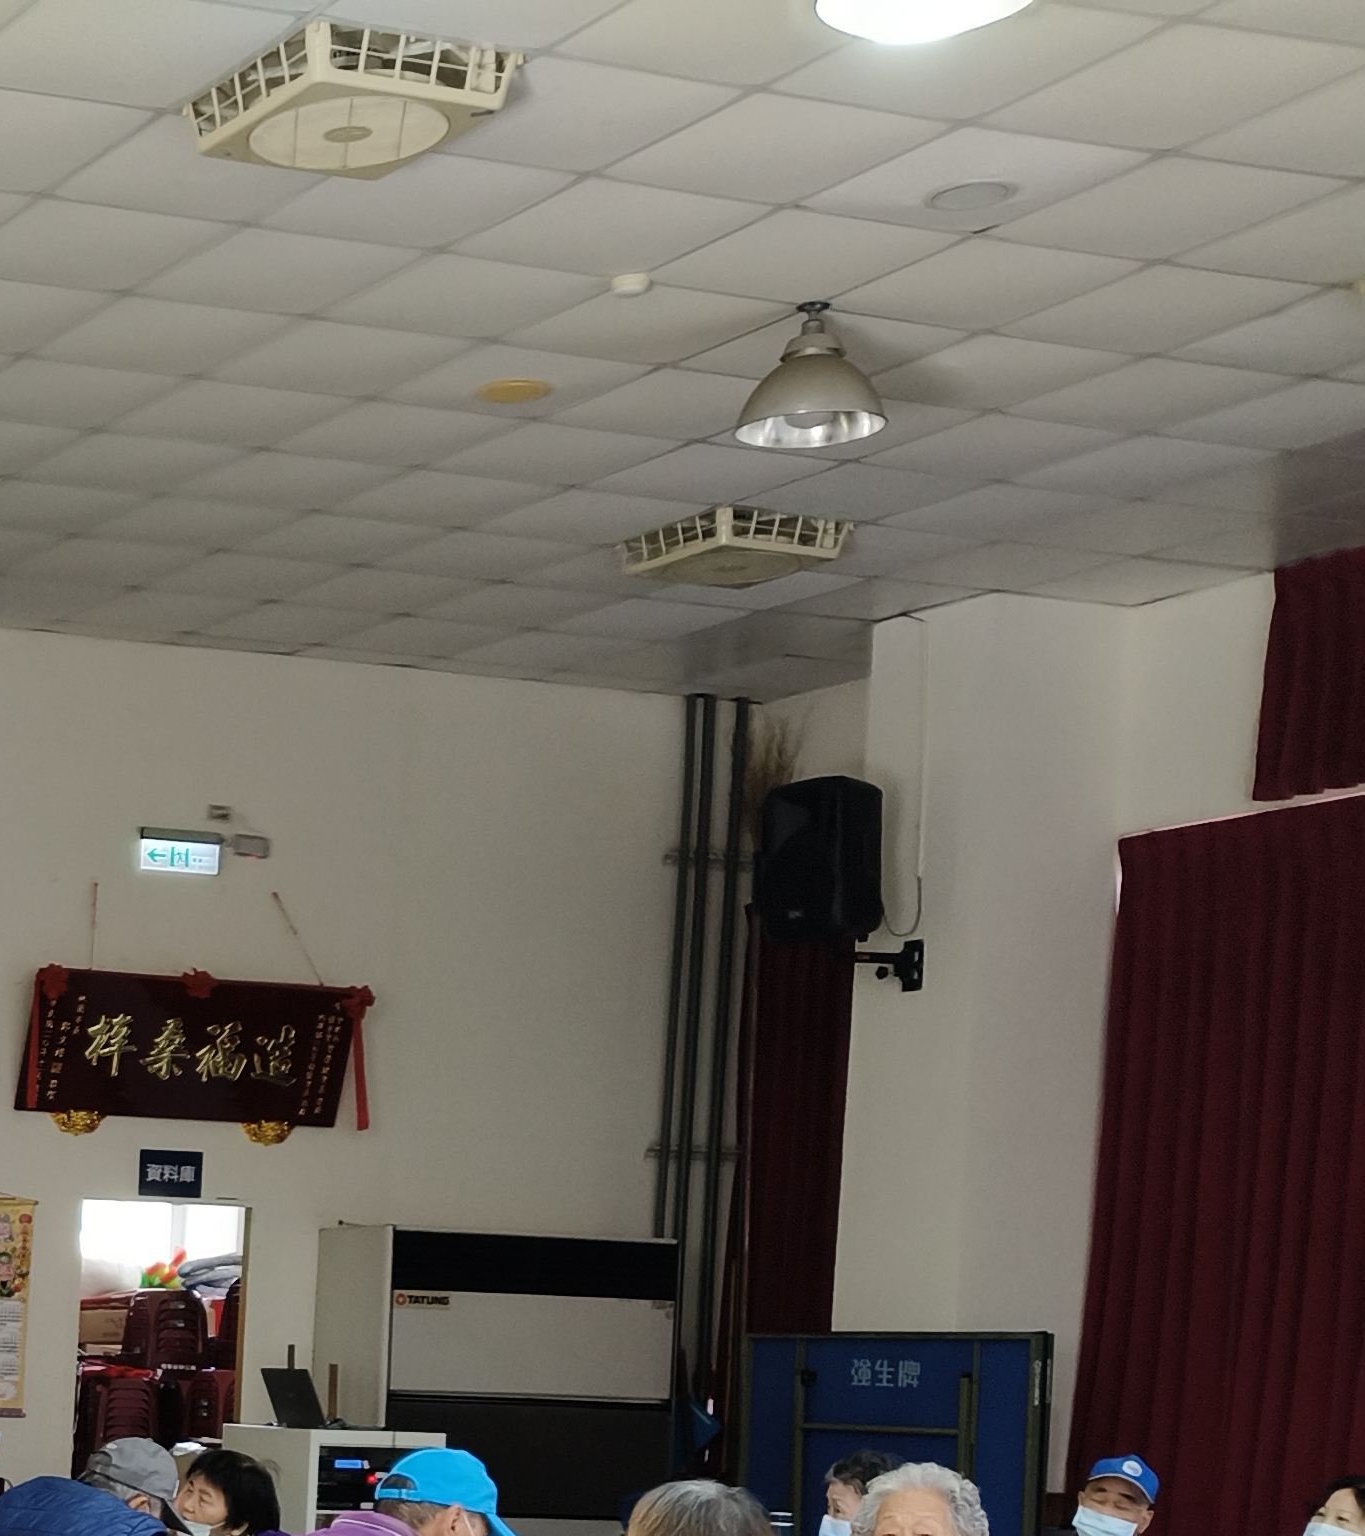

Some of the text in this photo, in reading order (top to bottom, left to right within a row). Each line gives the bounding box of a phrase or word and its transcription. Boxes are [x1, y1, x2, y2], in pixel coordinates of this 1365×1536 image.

[146, 1163, 196, 1183] 資料庫
[407, 1295, 450, 1306] TATUNG
[851, 1358, 921, 1388] 強生牌
